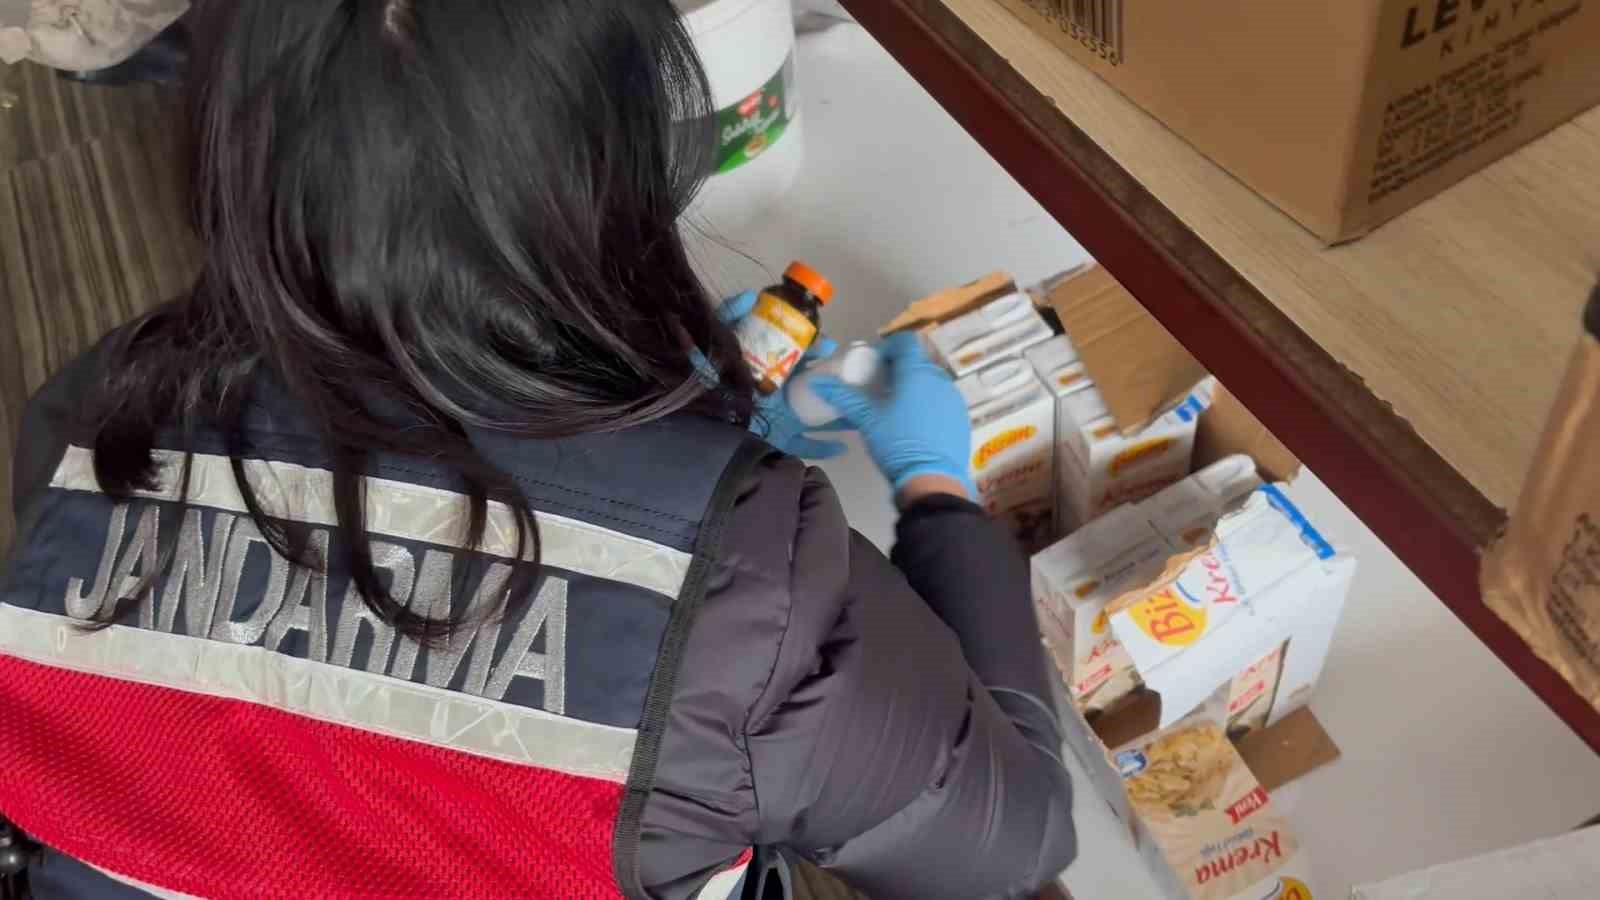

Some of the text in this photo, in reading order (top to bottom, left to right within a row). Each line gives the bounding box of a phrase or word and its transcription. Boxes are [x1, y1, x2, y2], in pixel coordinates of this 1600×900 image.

[1400, 0, 1486, 48] LE
[1200, 551, 1238, 603] Kre
[64, 500, 567, 715] JANDARMA
[1195, 829, 1281, 884] Krema
